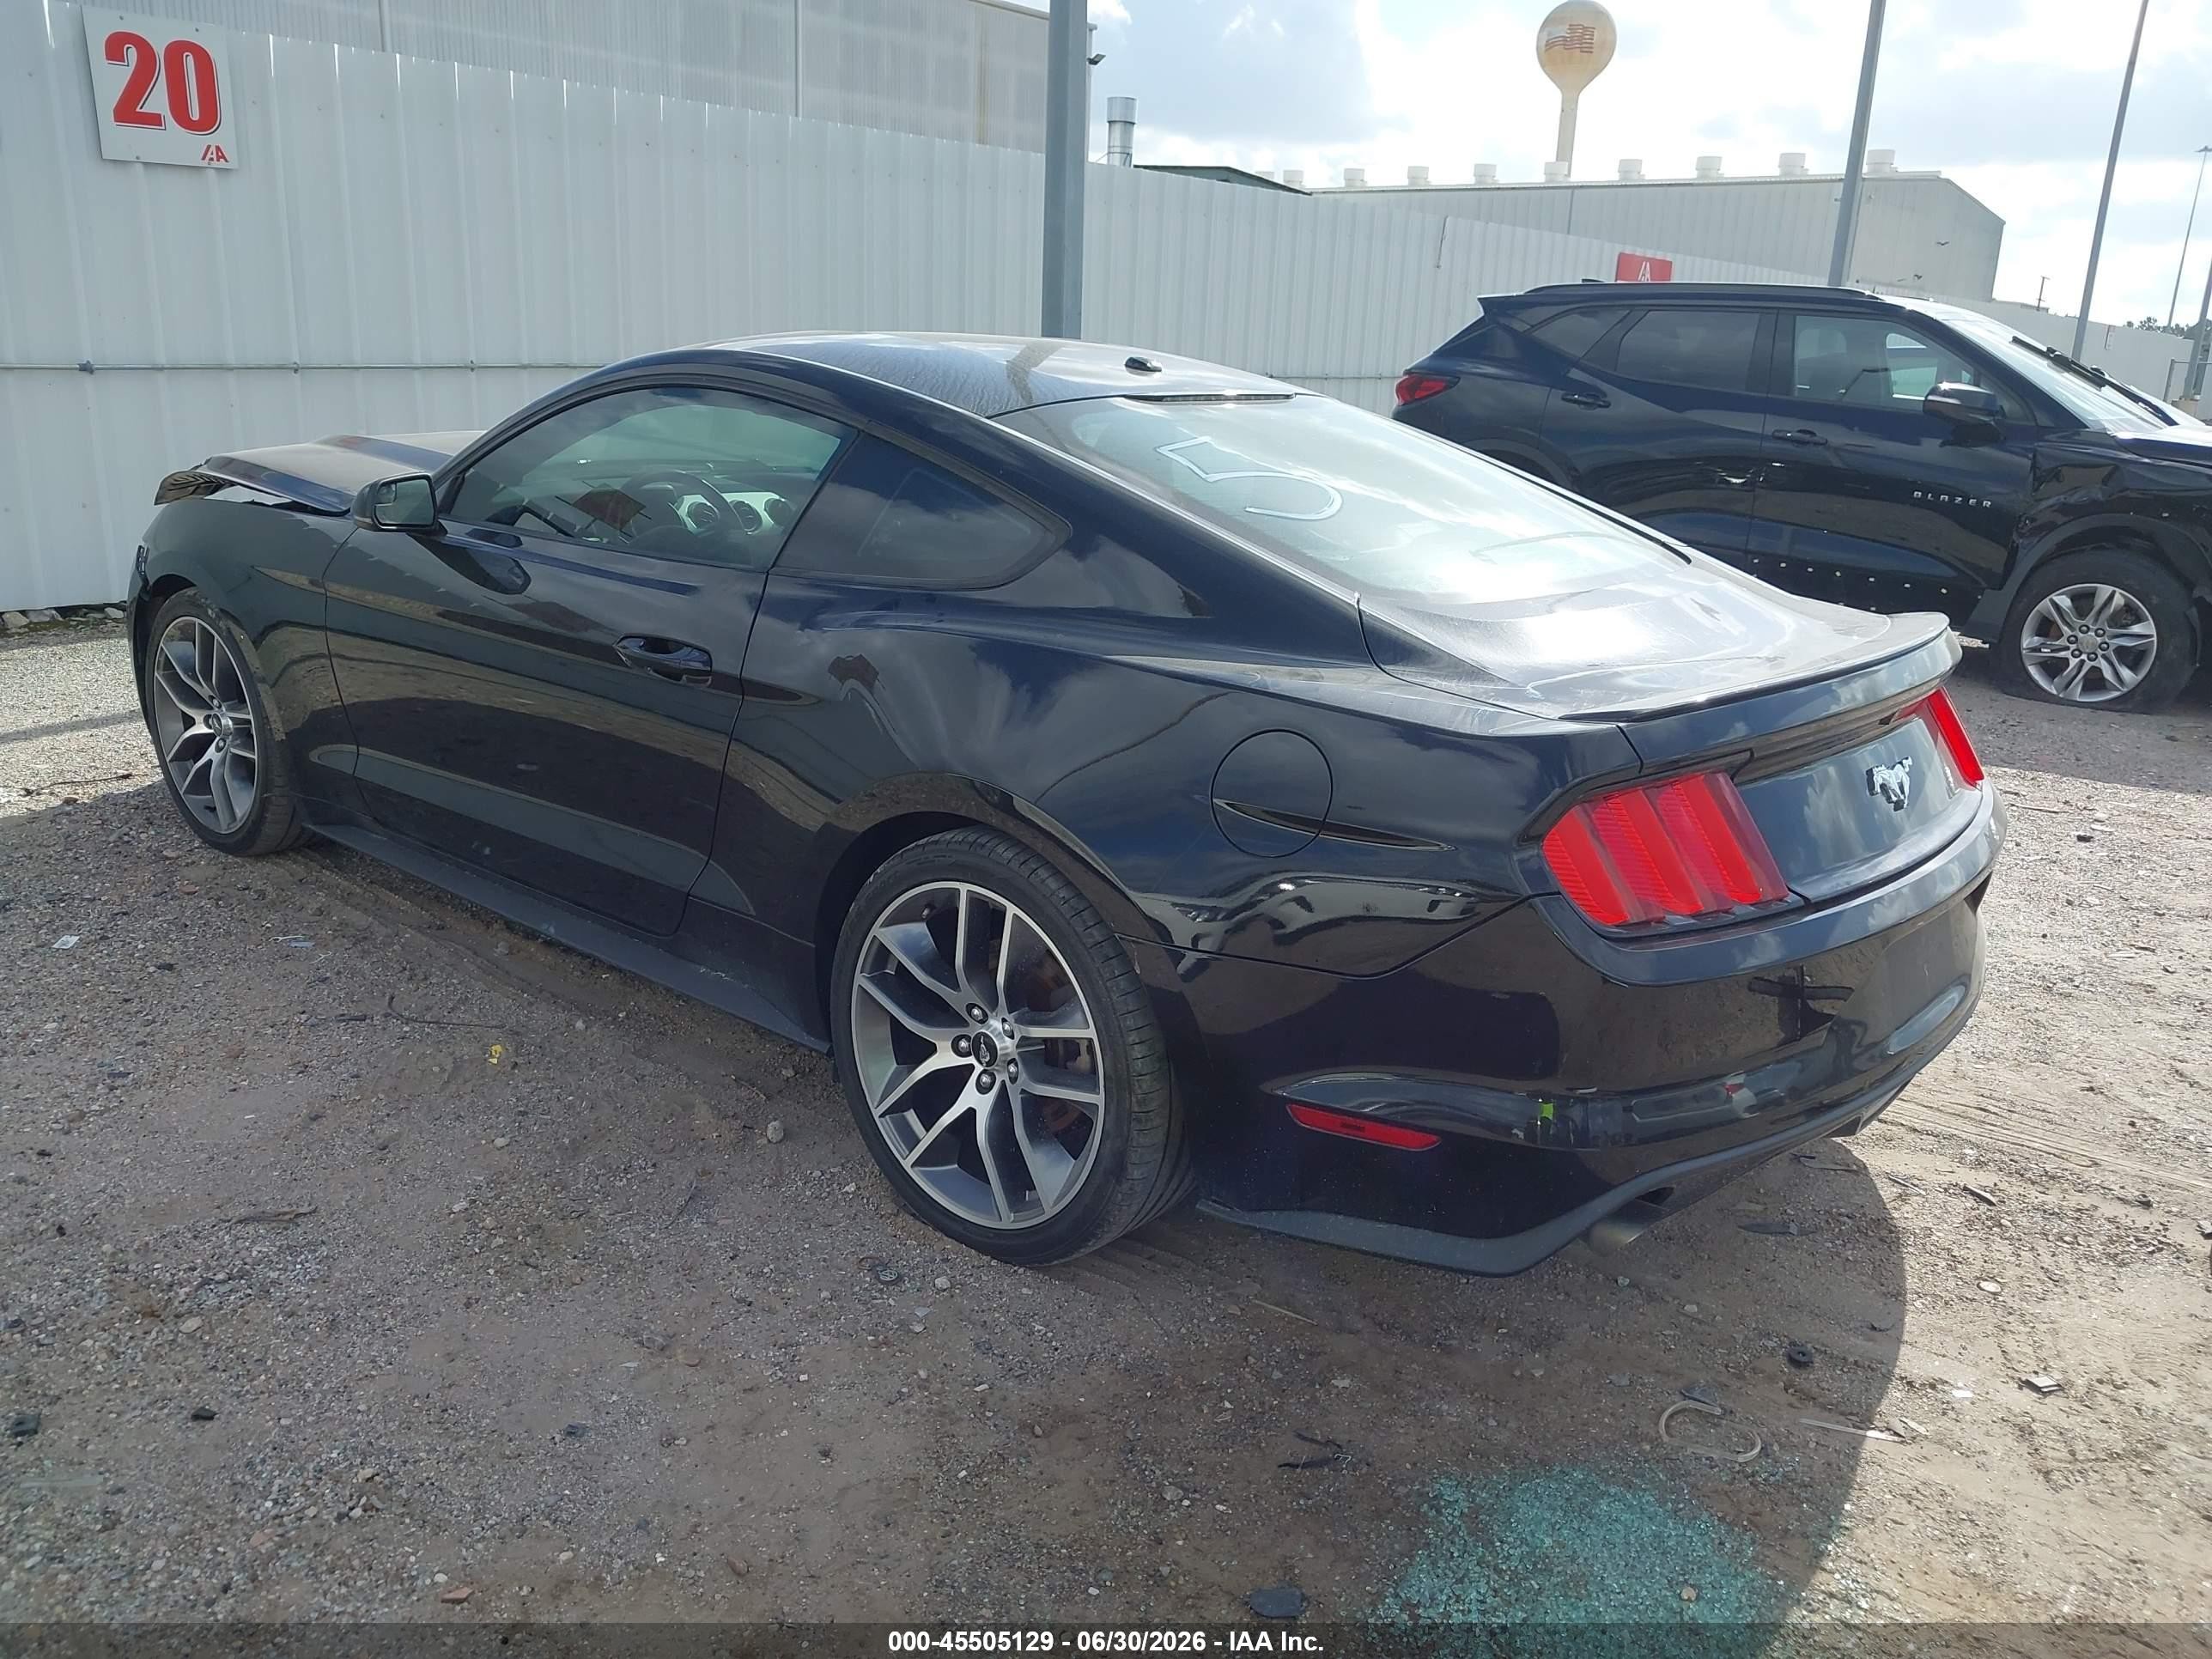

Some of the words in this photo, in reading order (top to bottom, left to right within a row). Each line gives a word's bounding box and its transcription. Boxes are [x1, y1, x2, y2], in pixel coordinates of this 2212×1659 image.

[104, 30, 222, 137] 20
[1155, 435, 1343, 520] 5
[1913, 490, 1992, 508] BLAZER
